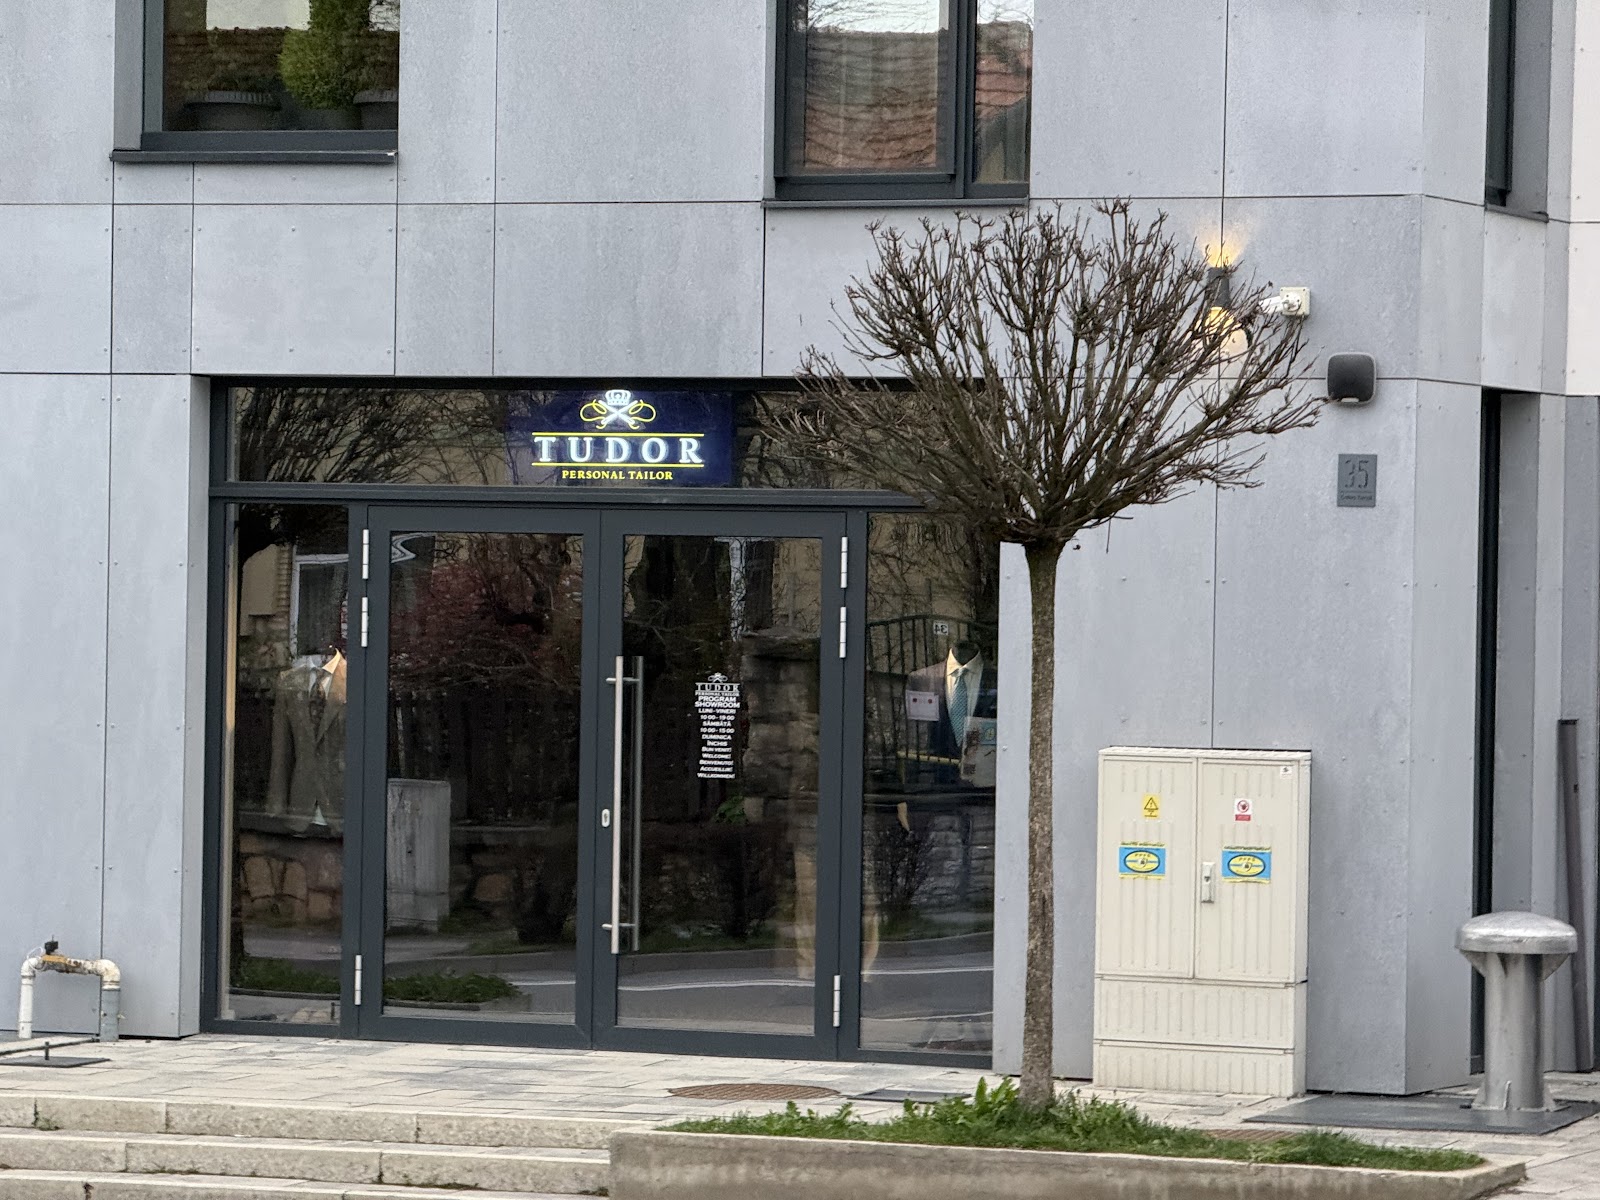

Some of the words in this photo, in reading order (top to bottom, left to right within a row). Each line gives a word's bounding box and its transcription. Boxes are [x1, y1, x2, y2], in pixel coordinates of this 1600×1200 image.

[534, 437, 703, 464] TUDOR
[562, 470, 625, 480] PERSONAL
[628, 470, 673, 480] TAILOR
[1345, 460, 1369, 488] 35
[696, 683, 739, 692] TUDOR
